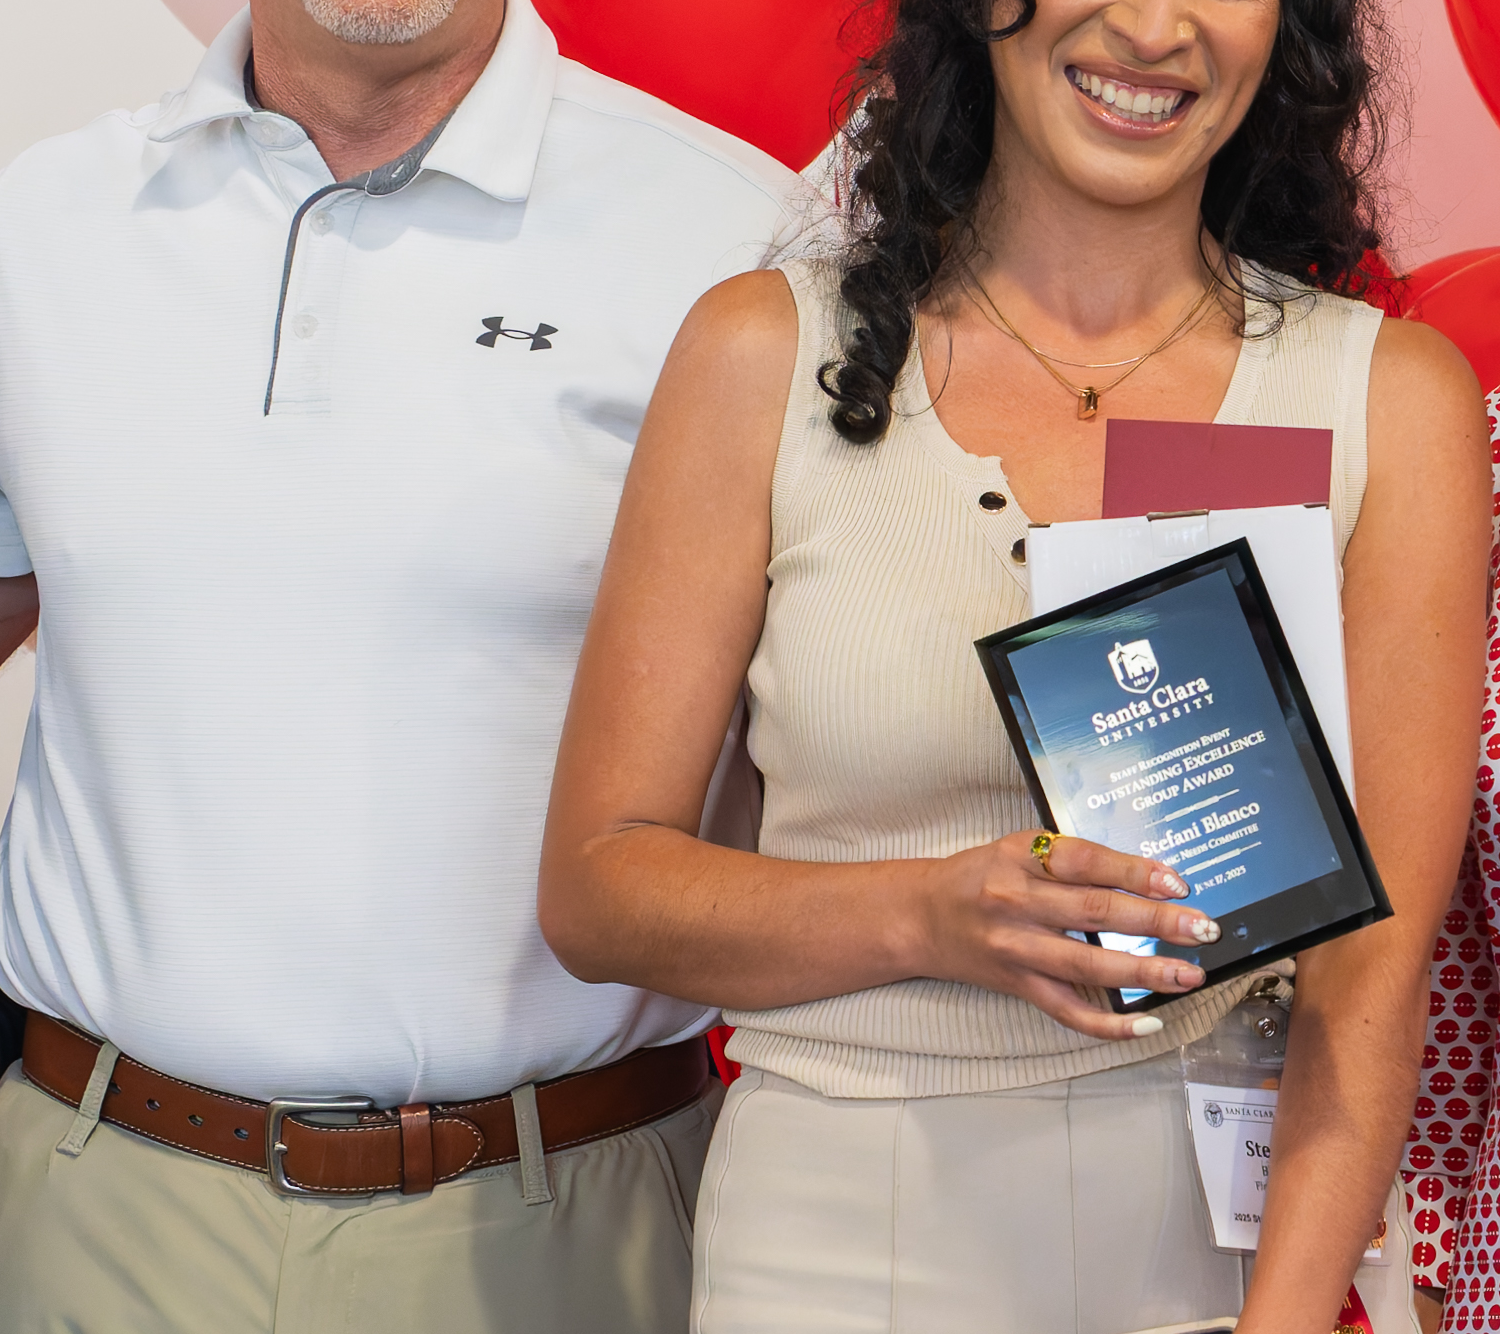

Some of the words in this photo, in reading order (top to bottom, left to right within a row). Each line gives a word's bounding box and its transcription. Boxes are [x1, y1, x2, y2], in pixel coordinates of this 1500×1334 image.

[1092, 700, 1153, 734] Santa
[1152, 677, 1210, 709] Clara
[1099, 693, 1215, 747] UNIVERSITY
[1087, 763, 1183, 810] OUTSTANDING
[1183, 730, 1266, 772] EXCELLENCE
[1110, 765, 1138, 783] STAFF
[1138, 740, 1200, 772] RECOGNITION
[1200, 727, 1231, 747] EVENT
[1132, 784, 1180, 812] GROUP
[1183, 763, 1235, 793] AWARD
[1139, 822, 1202, 858] Stefani
[1200, 802, 1260, 834] Blanco
[1162, 853, 1181, 866] ASIC
[1225, 1107, 1251, 1117] SANTA
